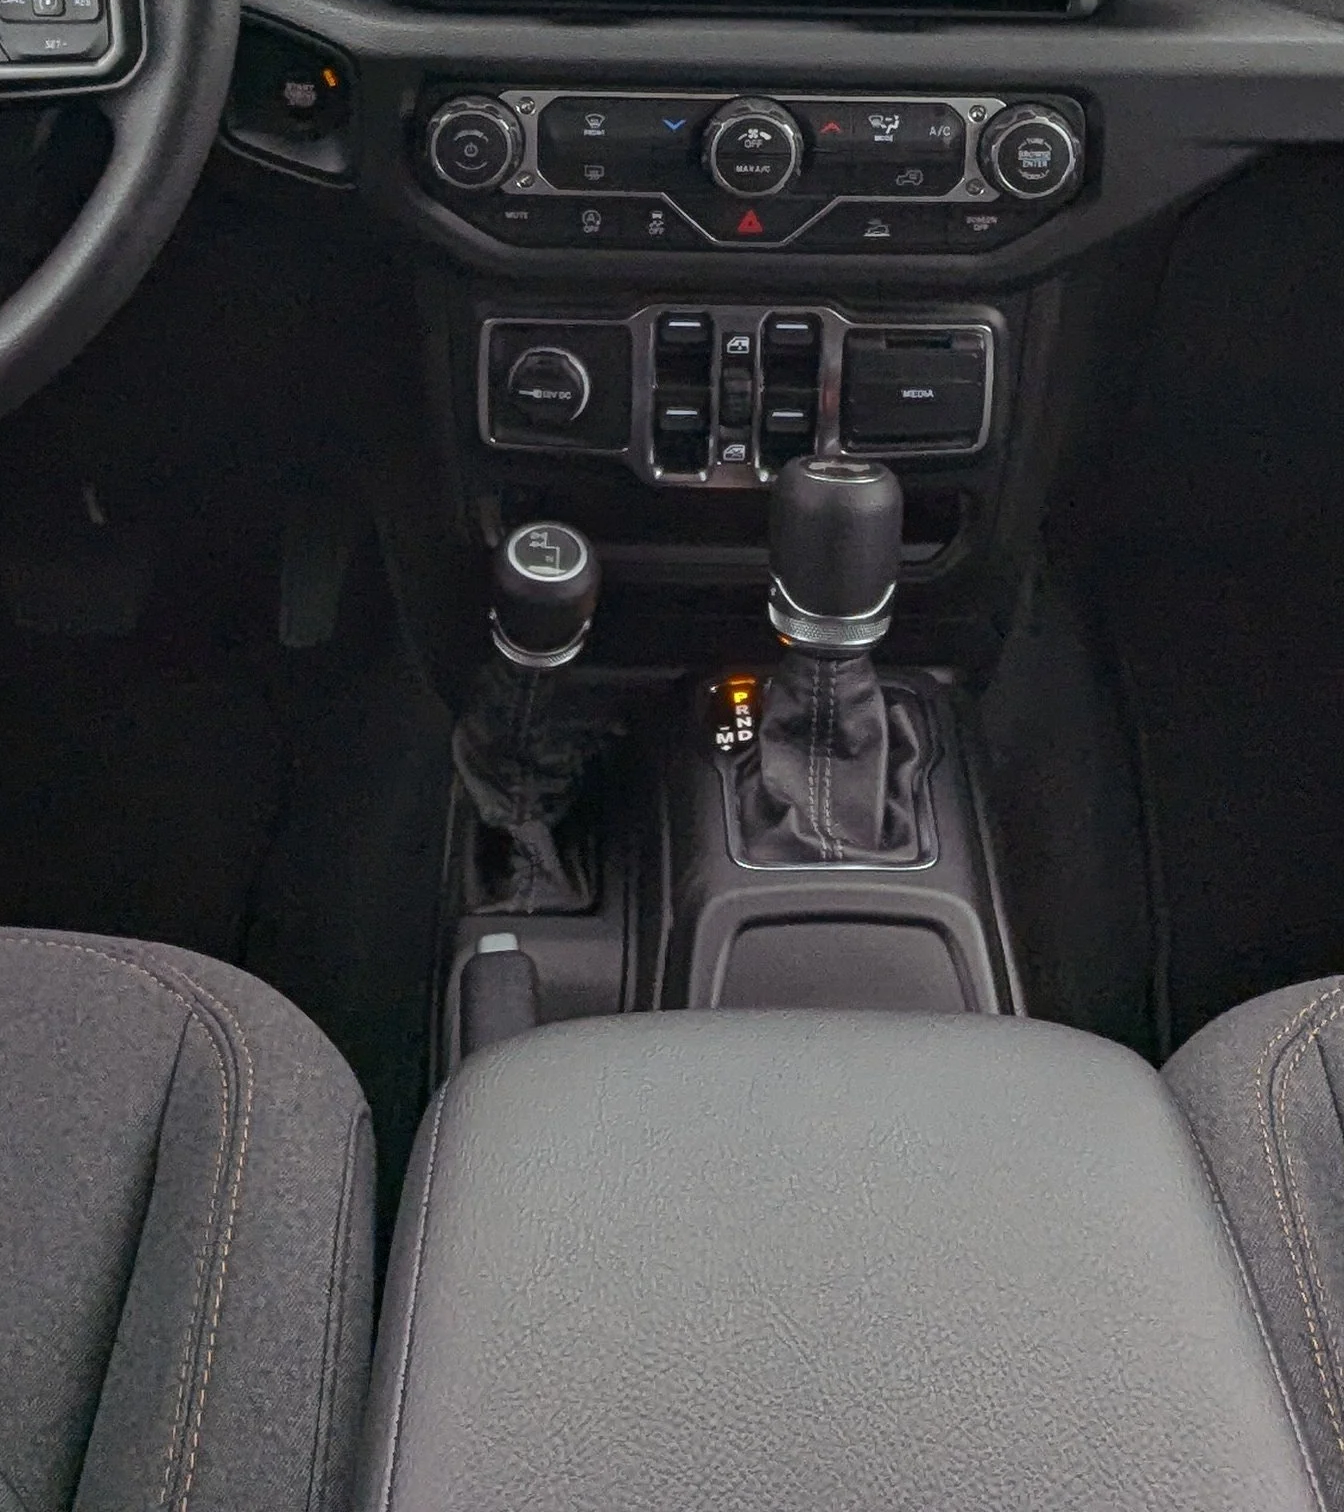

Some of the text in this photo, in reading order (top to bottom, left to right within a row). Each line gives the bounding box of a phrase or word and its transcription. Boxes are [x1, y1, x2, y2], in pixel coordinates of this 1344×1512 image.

[929, 125, 951, 137] A/C
[744, 139, 763, 148] OFF
[504, 211, 529, 220] MUTE
[902, 389, 935, 398] MEDIA
[733, 691, 748, 703] P
[735, 704, 750, 716] R
[736, 716, 753, 728] N
[716, 731, 735, 745] M
[737, 730, 754, 742] D
